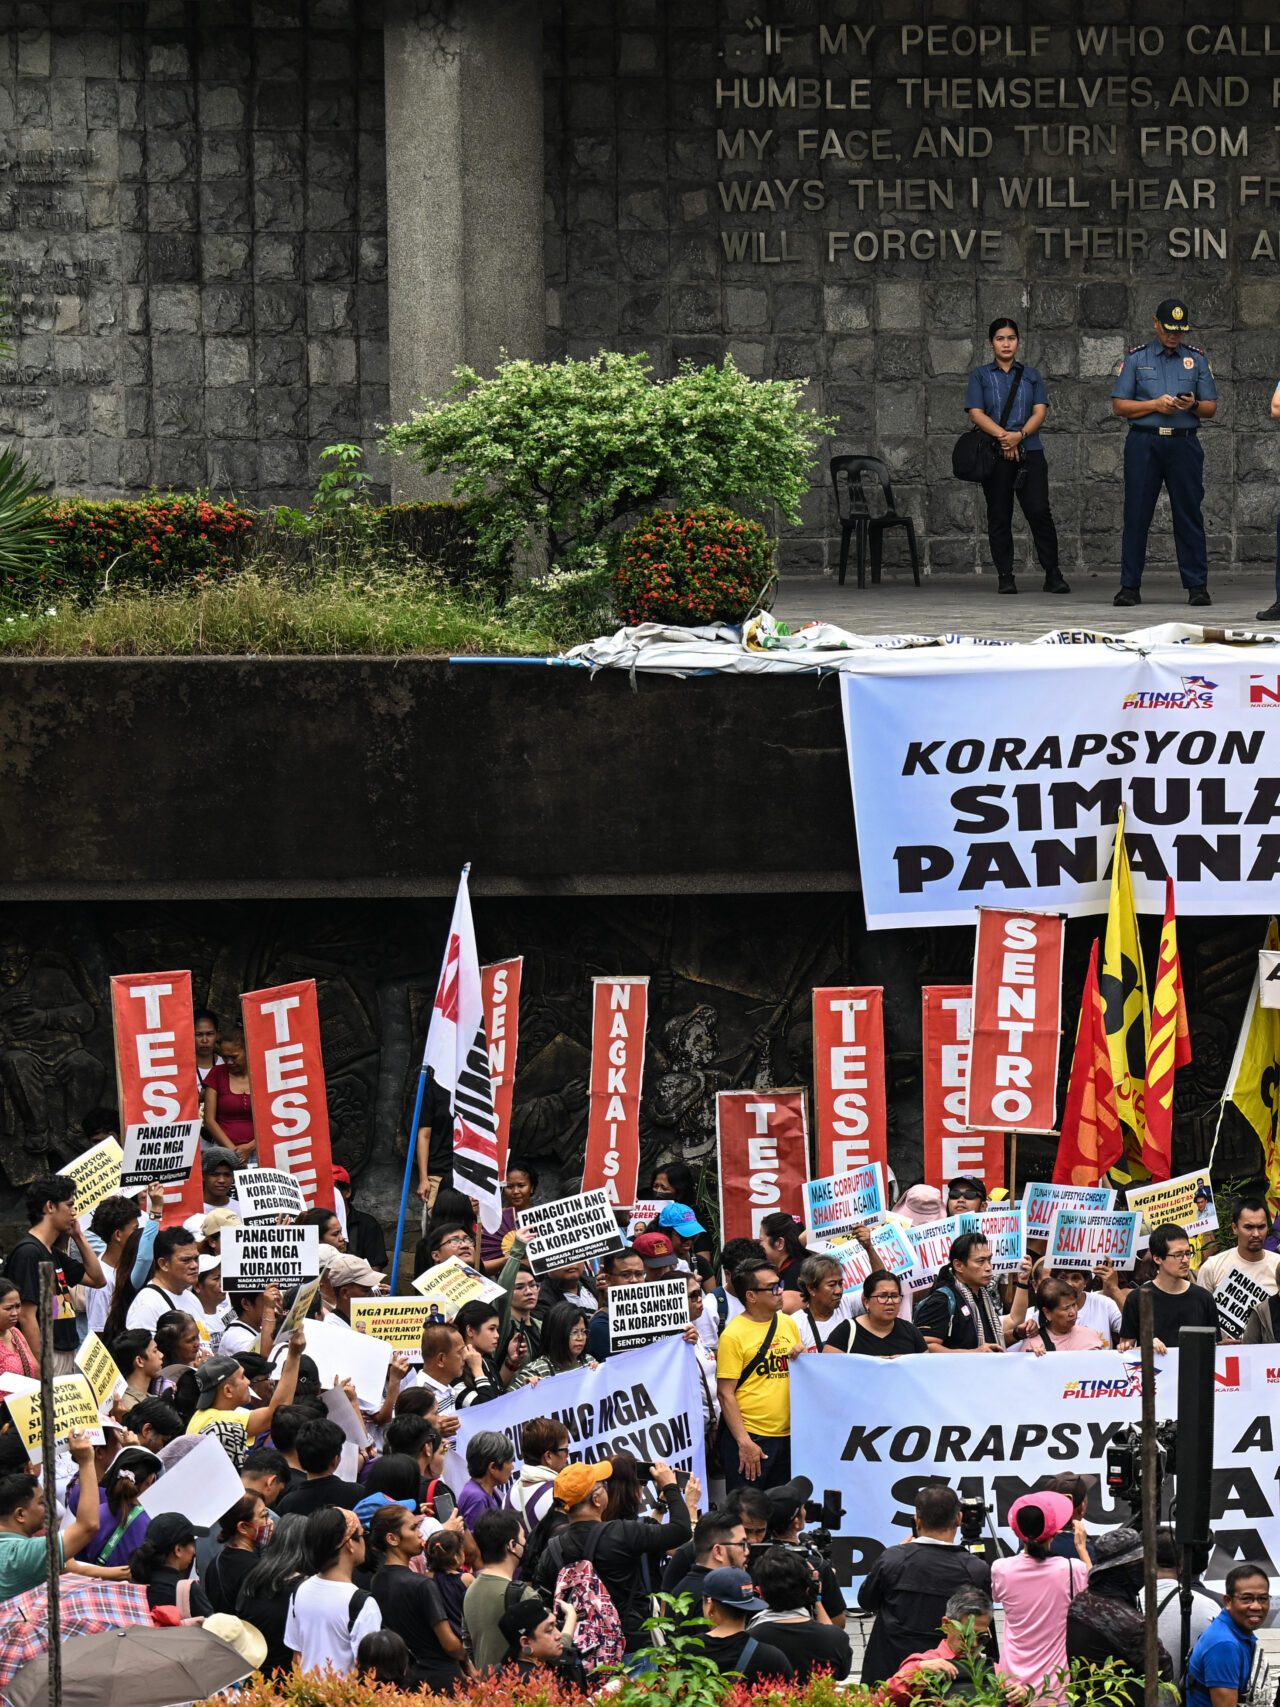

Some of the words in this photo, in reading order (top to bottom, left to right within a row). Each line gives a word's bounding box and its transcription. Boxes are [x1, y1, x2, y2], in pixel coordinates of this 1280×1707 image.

[819, 24, 876, 55] MY
[901, 25, 1052, 56] PEOPLE
[1076, 25, 1165, 56] WHO
[716, 78, 872, 109] HUMBLE
[896, 77, 1160, 110] THEMSELVES,
[1169, 76, 1249, 107] AND
[717, 129, 773, 160] MY
[798, 129, 901, 163] FACE,
[913, 127, 993, 159] AND
[1014, 125, 1118, 156] TURN
[1140, 125, 1248, 157] FROM
[718, 179, 824, 212] WAYS
[849, 178, 953, 210] THEN
[972, 177, 978, 208] I
[999, 177, 1090, 208] WILL
[1110, 177, 1216, 210] HEAR
[722, 231, 799, 263] WILL
[828, 229, 1002, 262] FORGIVE
[1036, 227, 1148, 259] THEIR
[1168, 227, 1228, 259] SIN
[902, 730, 1265, 776] KORAPSYON
[991, 918, 1038, 1122] SENTRO
[602, 985, 631, 1204] NAGKAISA
[136, 1124, 192, 1140] PANAGUTIN
[140, 1141, 162, 1156] ANG
[163, 1140, 184, 1154] MGA
[135, 1156, 183, 1172] KURAKOT!
[125, 1174, 153, 1184] SENTRO
[811, 1183, 833, 1204] MAKE
[833, 1170, 876, 1198] CORRUPTION
[521, 1200, 582, 1226] PANAGUTIN
[584, 1192, 607, 1209] ANG
[555, 1207, 606, 1232] SANGKOT
[813, 1202, 852, 1226] SHAMEFUL
[853, 1195, 878, 1216] AGAIN!
[1060, 1214, 1078, 1225] TUNAY
[1080, 1216, 1087, 1225] NA
[1088, 1215, 1112, 1226] LIFESTYLE
[1112, 1216, 1132, 1226] CHECK?
[235, 1228, 305, 1244] PANAGUTIN
[529, 1240, 546, 1255] SA
[548, 1220, 616, 1250] KORAPSYON!
[1056, 1226, 1086, 1252] SALN
[1087, 1228, 1132, 1254] ILABAS!
[242, 1246, 267, 1260] ANG
[270, 1245, 299, 1258] MGA
[1054, 1258, 1092, 1267] LIBERAL
[240, 1262, 302, 1276] KURAKOT!
[611, 1284, 666, 1302] PANAGUTIN
[667, 1282, 686, 1296] ANG
[356, 1307, 382, 1317] MGA
[382, 1306, 429, 1316] PILIPINO
[616, 1302, 638, 1317] MGA
[640, 1297, 683, 1314] SANGKOT
[372, 1318, 395, 1326] HINDI
[396, 1317, 424, 1325] LIGTAS
[612, 1319, 626, 1332] SA
[628, 1311, 688, 1330] KORAPSYON!
[617, 1337, 647, 1348] SENTRO
[599, 1383, 658, 1434] MGA
